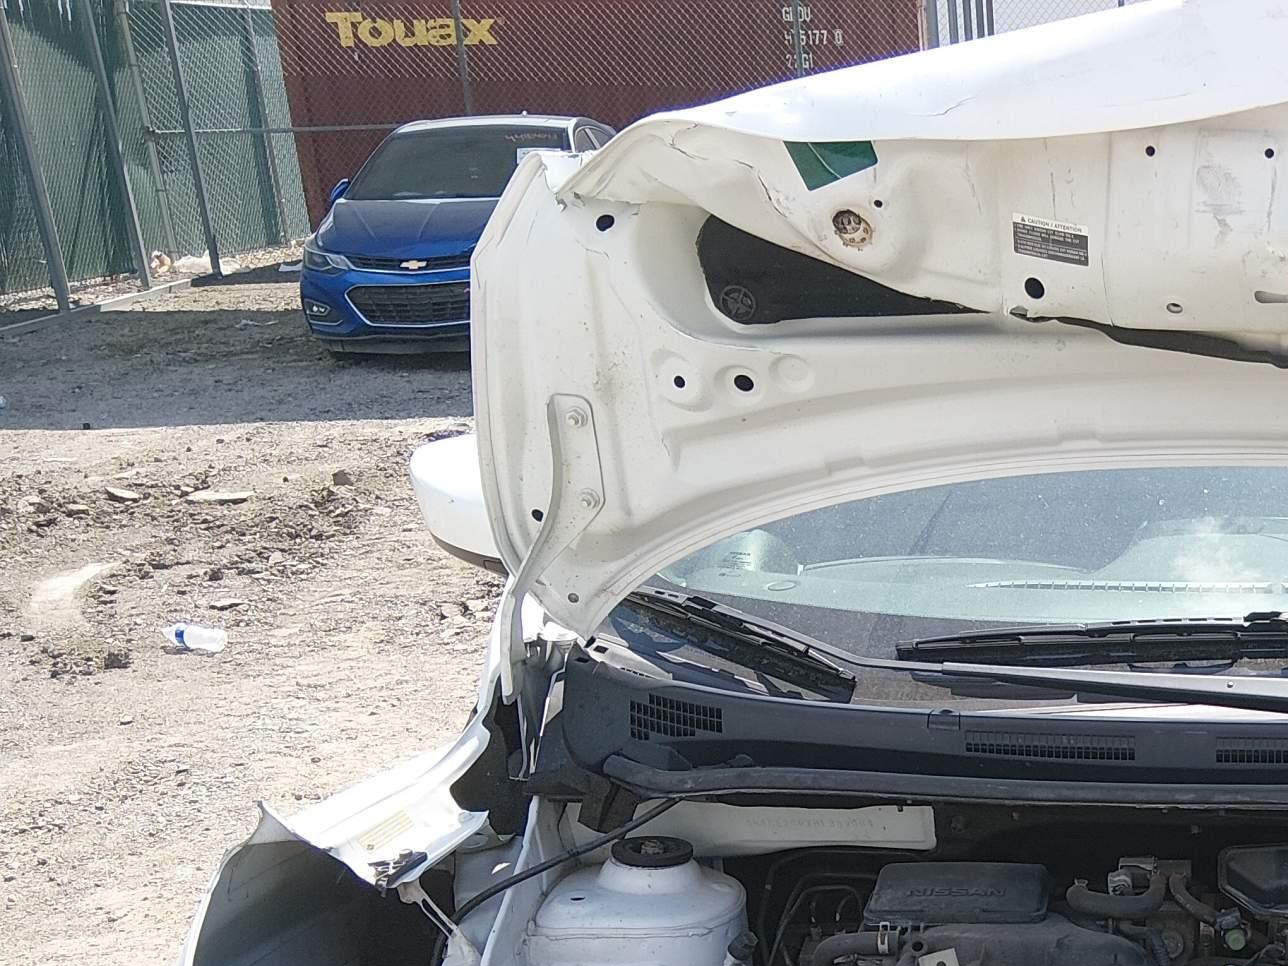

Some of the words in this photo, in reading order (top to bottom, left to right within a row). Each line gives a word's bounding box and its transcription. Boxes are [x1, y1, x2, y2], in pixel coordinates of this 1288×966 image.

[325, 12, 498, 47] Touax
[784, 29, 828, 46] 45177
[1027, 217, 1050, 227] CAUTION
[1054, 223, 1082, 232] ATTENTION
[903, 887, 1008, 898] NISSAN
